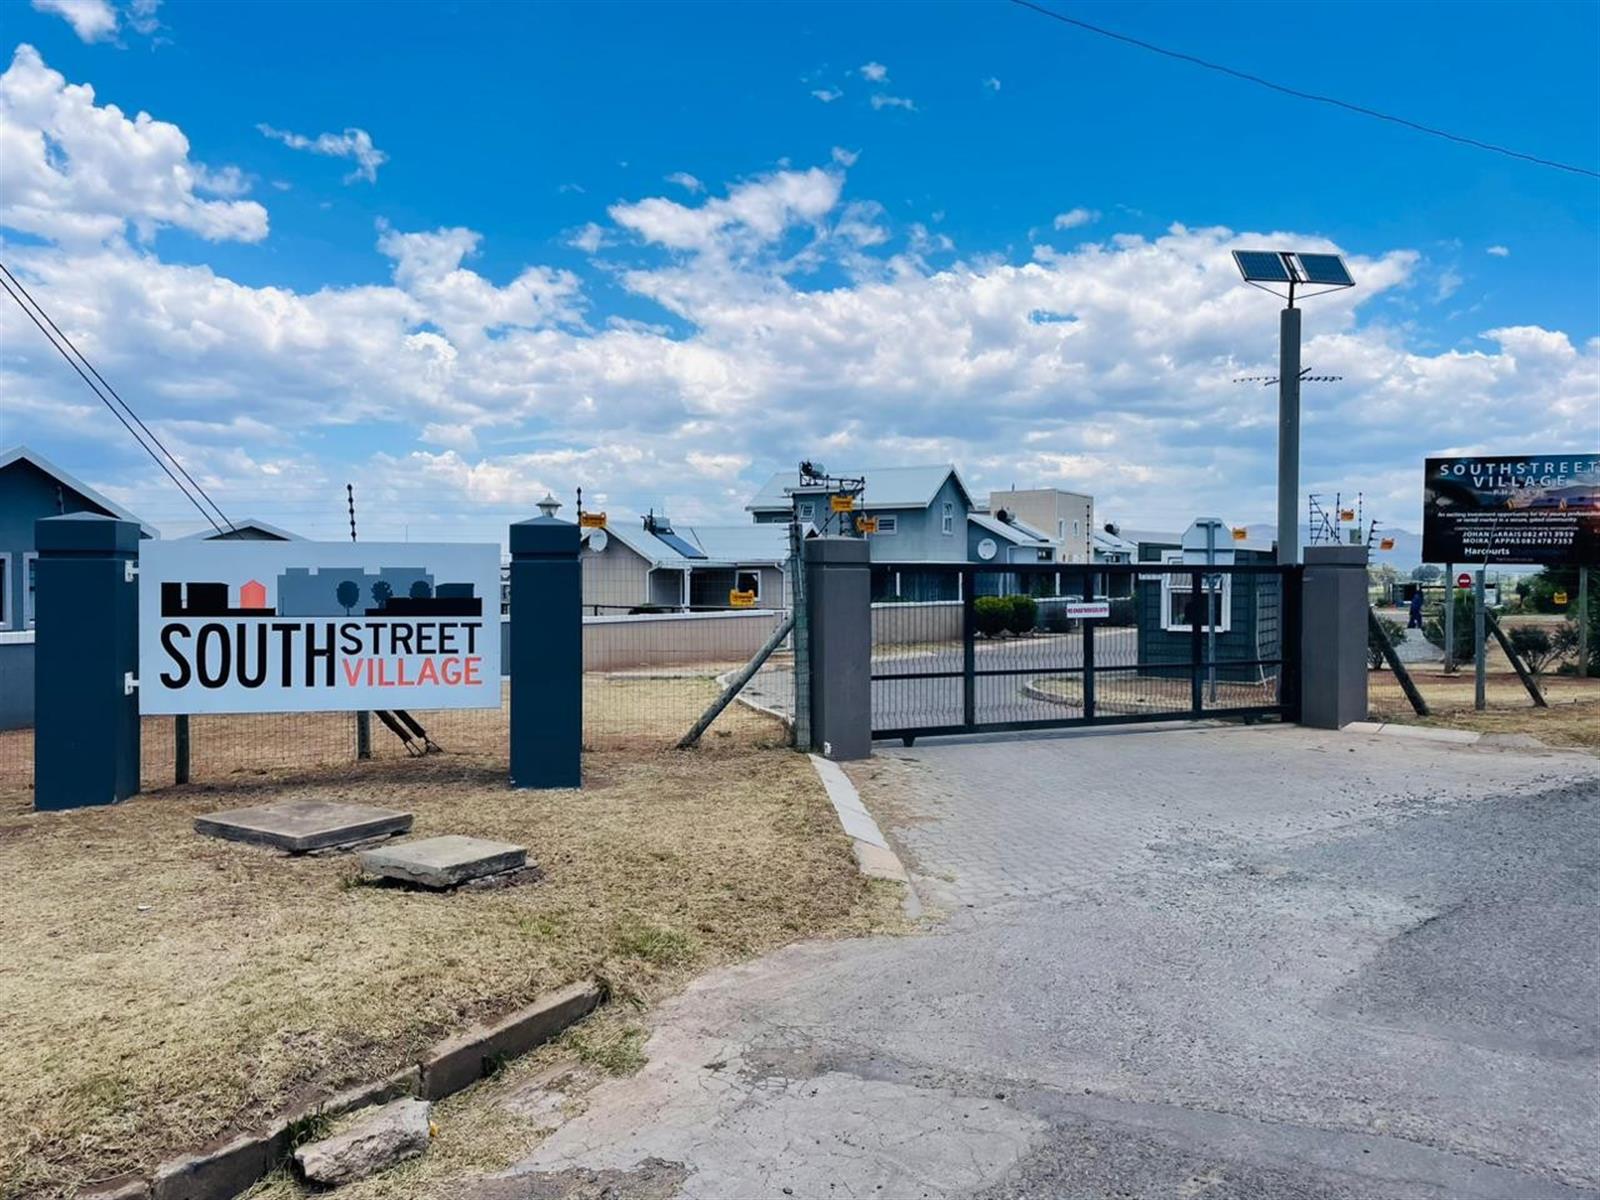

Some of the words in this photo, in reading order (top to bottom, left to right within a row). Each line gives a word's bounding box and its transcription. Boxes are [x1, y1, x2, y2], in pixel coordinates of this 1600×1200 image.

[1439, 462, 1598, 476] SOUTHSTREET
[1473, 475, 1567, 488] VILLAGE
[1464, 547, 1510, 556] Harcourts
[160, 622, 336, 690] SOUTH
[339, 622, 483, 655] STREET
[342, 656, 483, 686] VILLAGE
